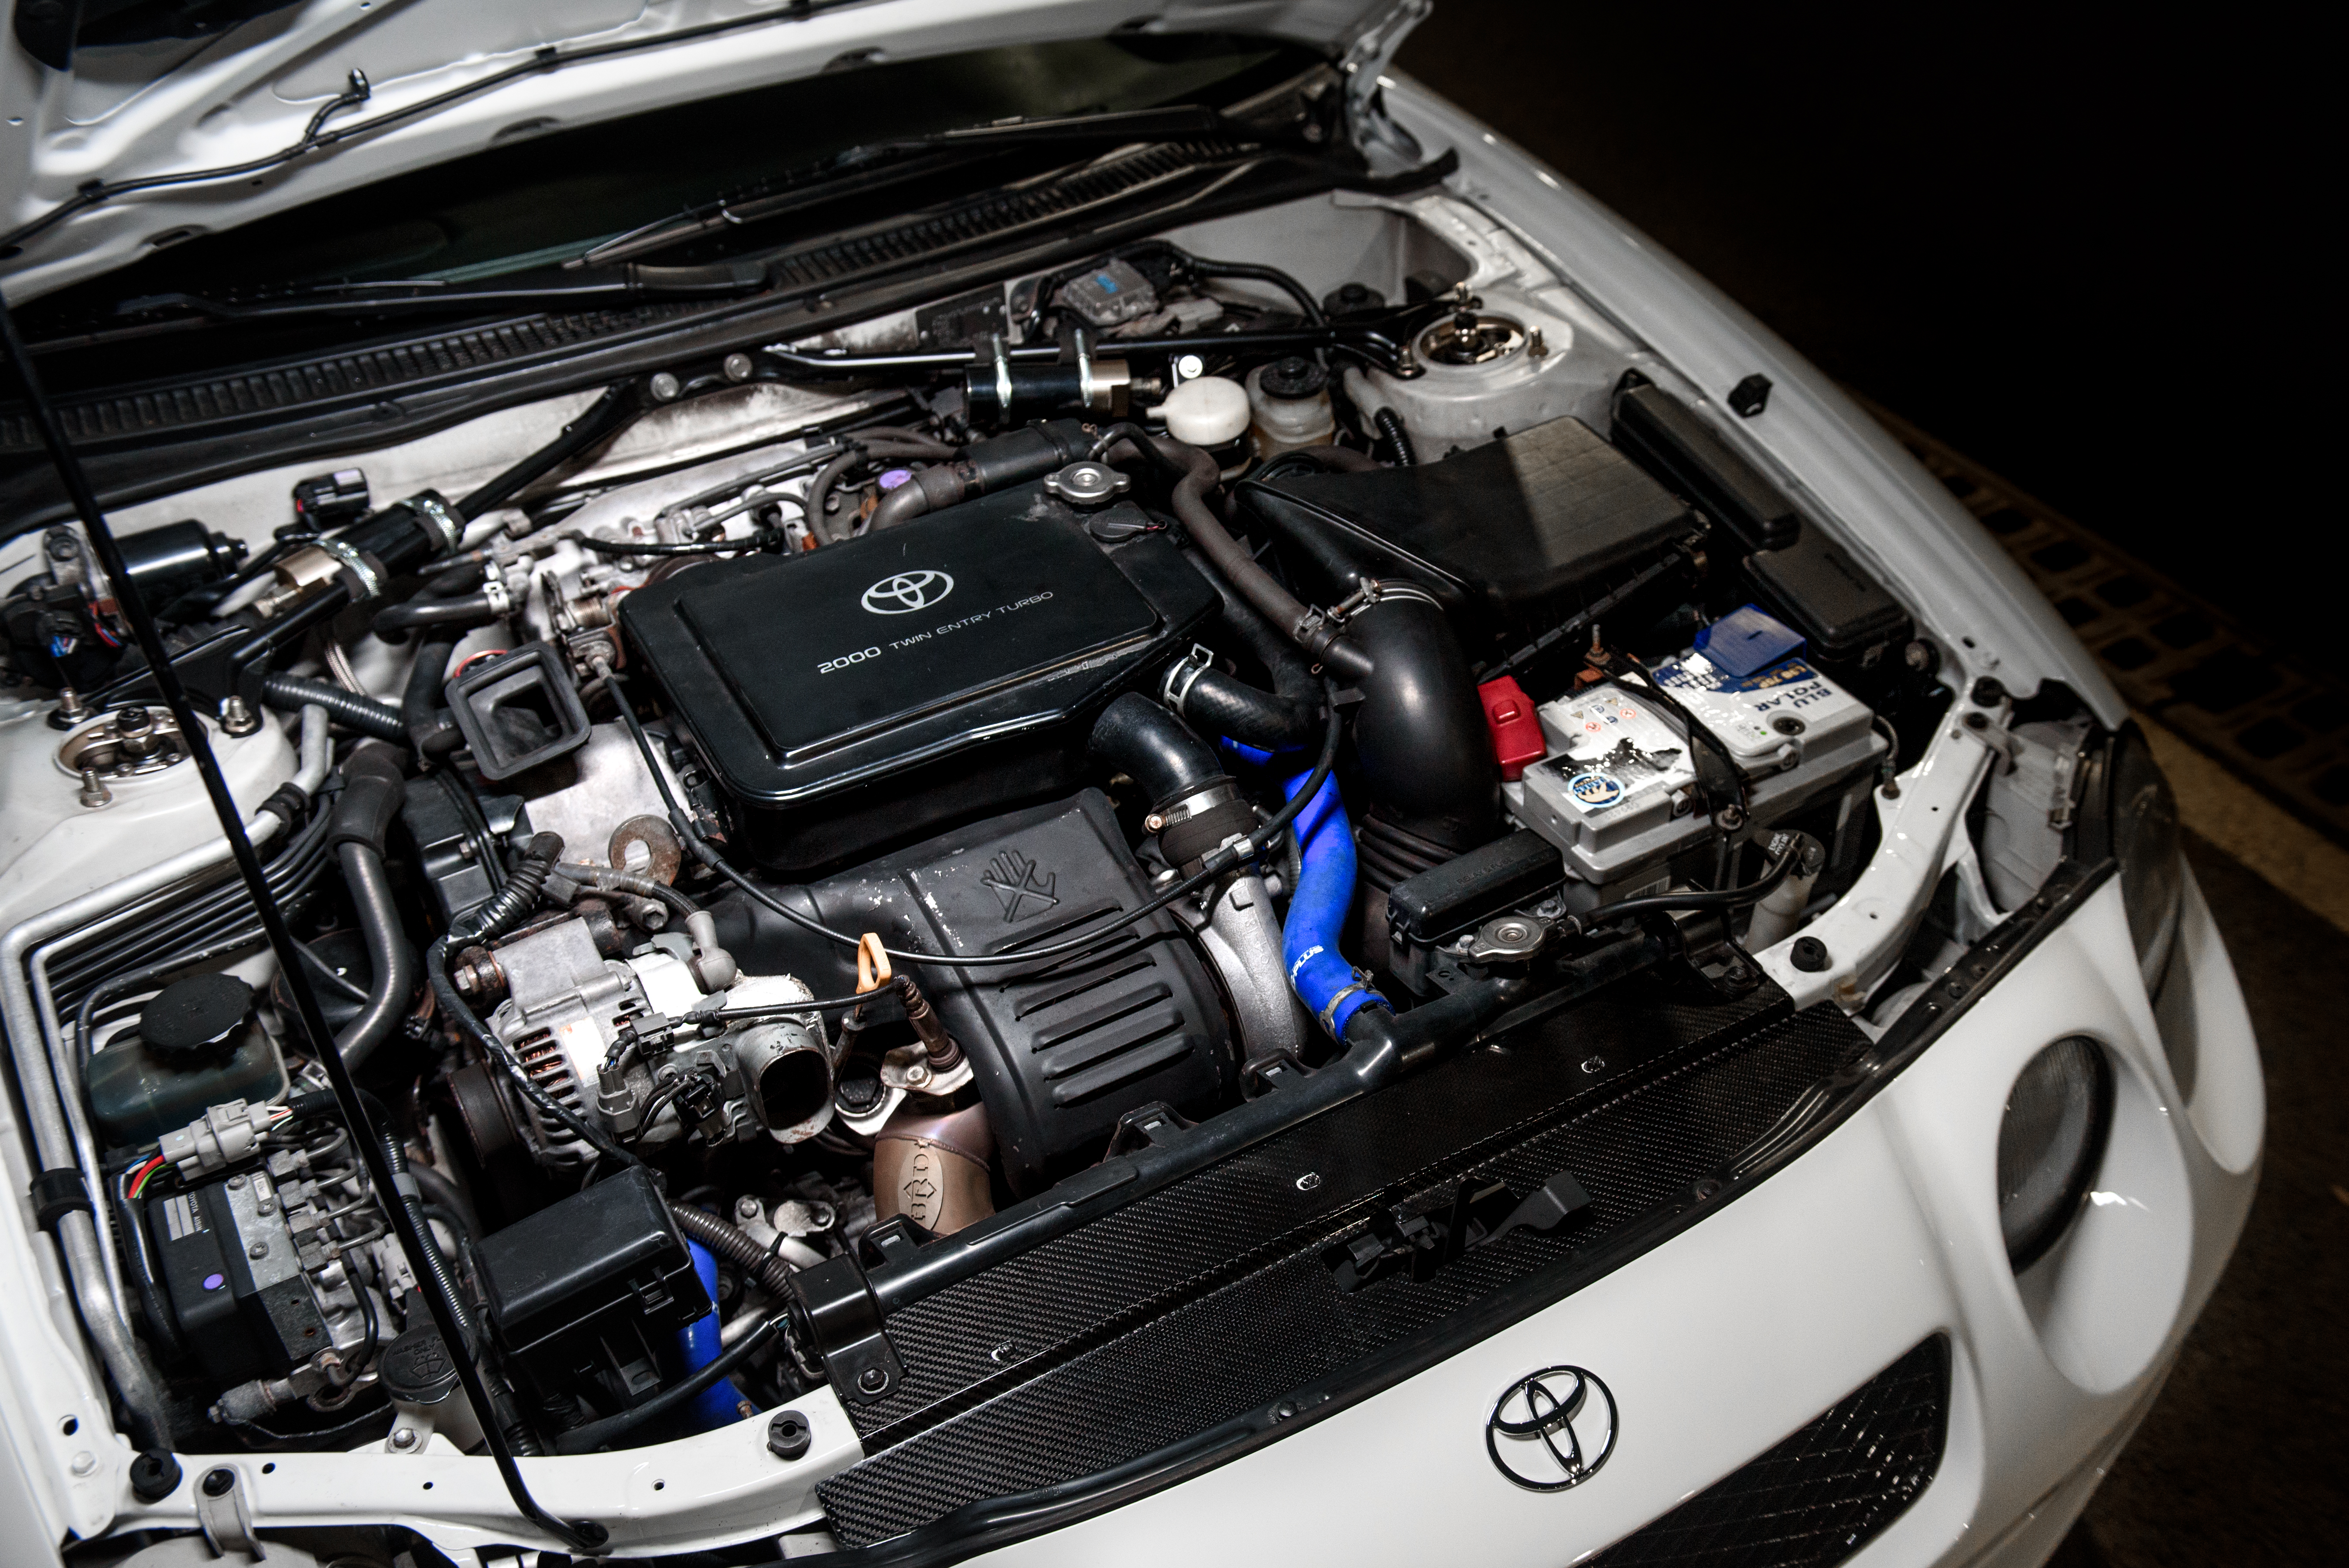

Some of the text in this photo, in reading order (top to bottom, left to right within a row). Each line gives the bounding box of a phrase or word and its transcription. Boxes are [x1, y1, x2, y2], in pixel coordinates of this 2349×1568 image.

[817, 591, 1053, 674] 2000 TWIN ENTRY TURBO
[1754, 681, 1821, 711] POLAR
[1793, 687, 1832, 708] BLU
[911, 1154, 929, 1226] BRD
[188, 1191, 203, 1232] TOYOTA AISIN
